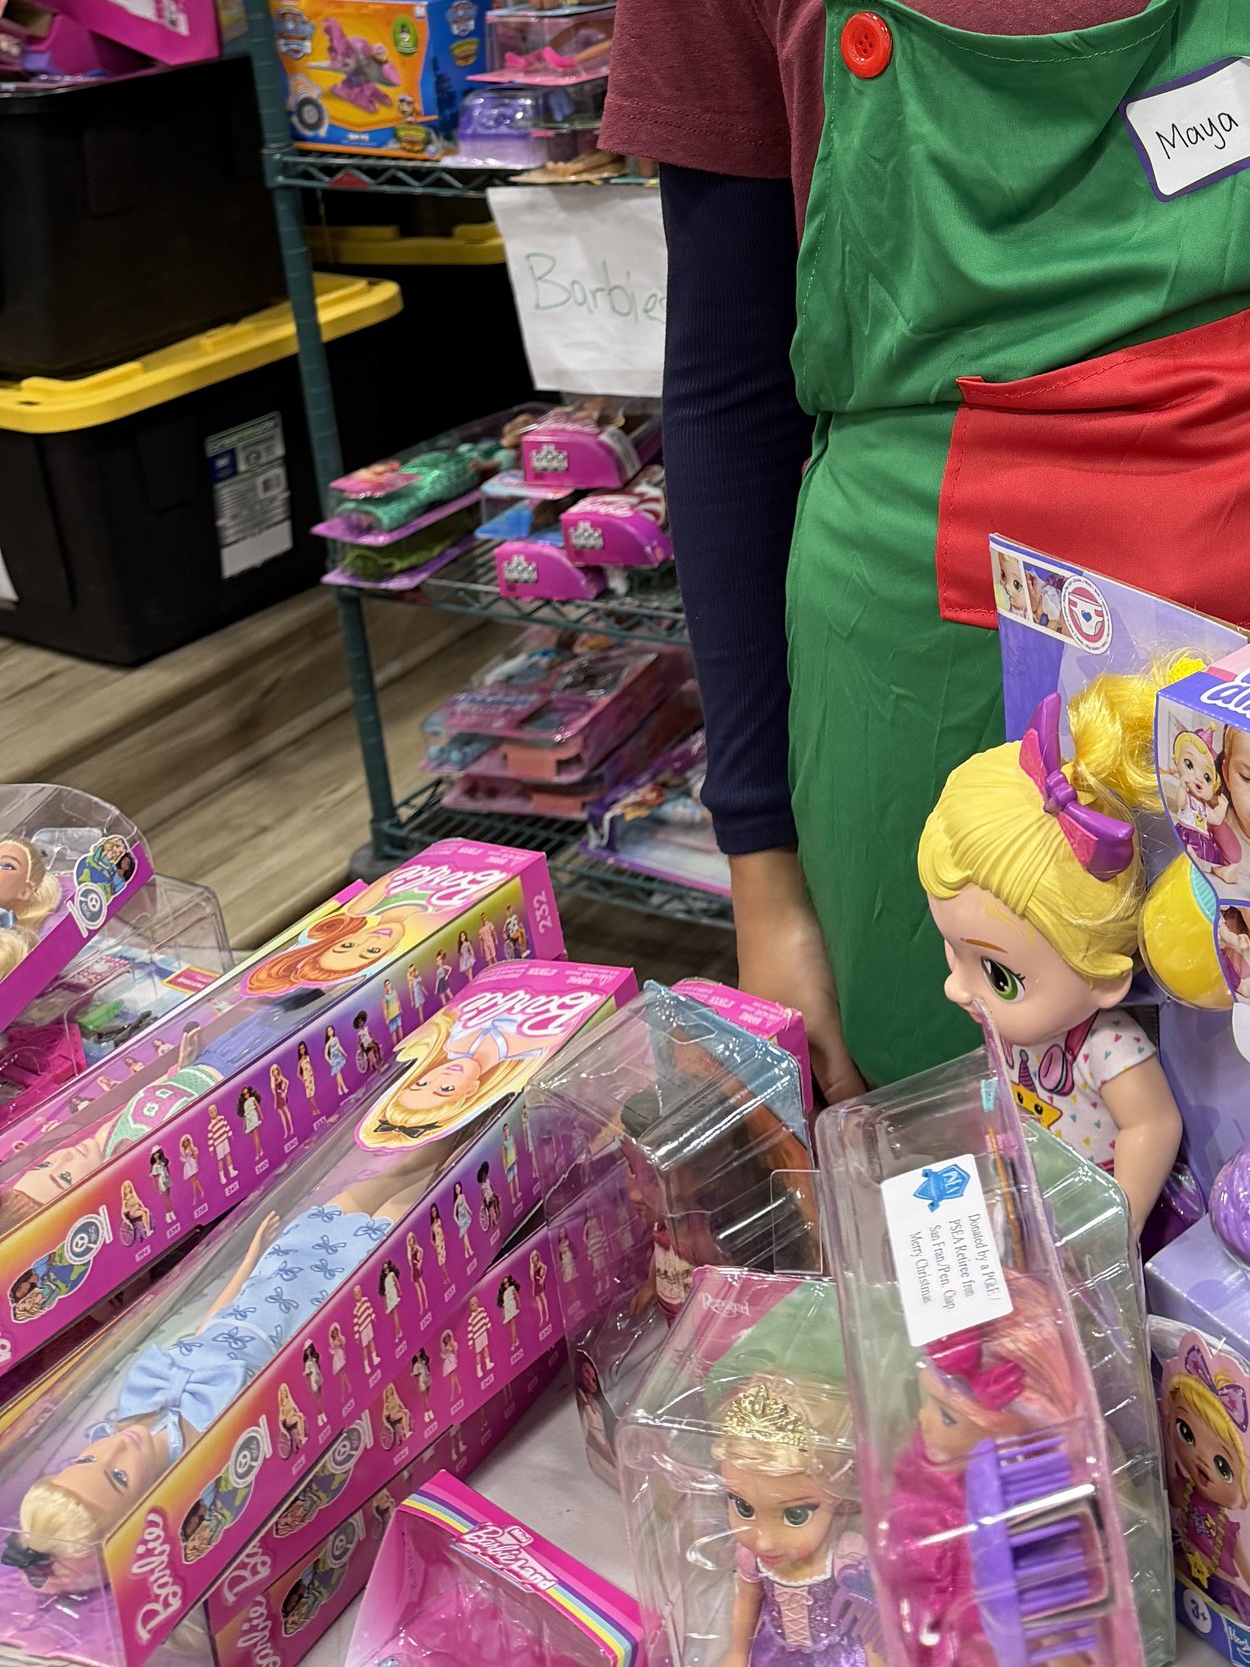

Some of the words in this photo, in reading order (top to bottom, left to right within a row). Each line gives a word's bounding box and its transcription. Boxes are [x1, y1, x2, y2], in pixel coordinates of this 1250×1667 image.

[1155, 108, 1239, 160] Maya
[526, 252, 667, 324] Barbie
[388, 863, 508, 906] Barbie
[532, 890, 554, 935] 232
[458, 990, 602, 1036] Barbie
[910, 1230, 925, 1258] Merry
[929, 1224, 942, 1238] San
[968, 1213, 985, 1250] Donated
[955, 1244, 970, 1280] Retiree
[975, 1248, 988, 1262] by
[914, 1257, 932, 1305] Christmas
[130, 1512, 183, 1643] Barbie
[236, 1595, 283, 1667] arbie
[1190, 1594, 1209, 1625] 3+
